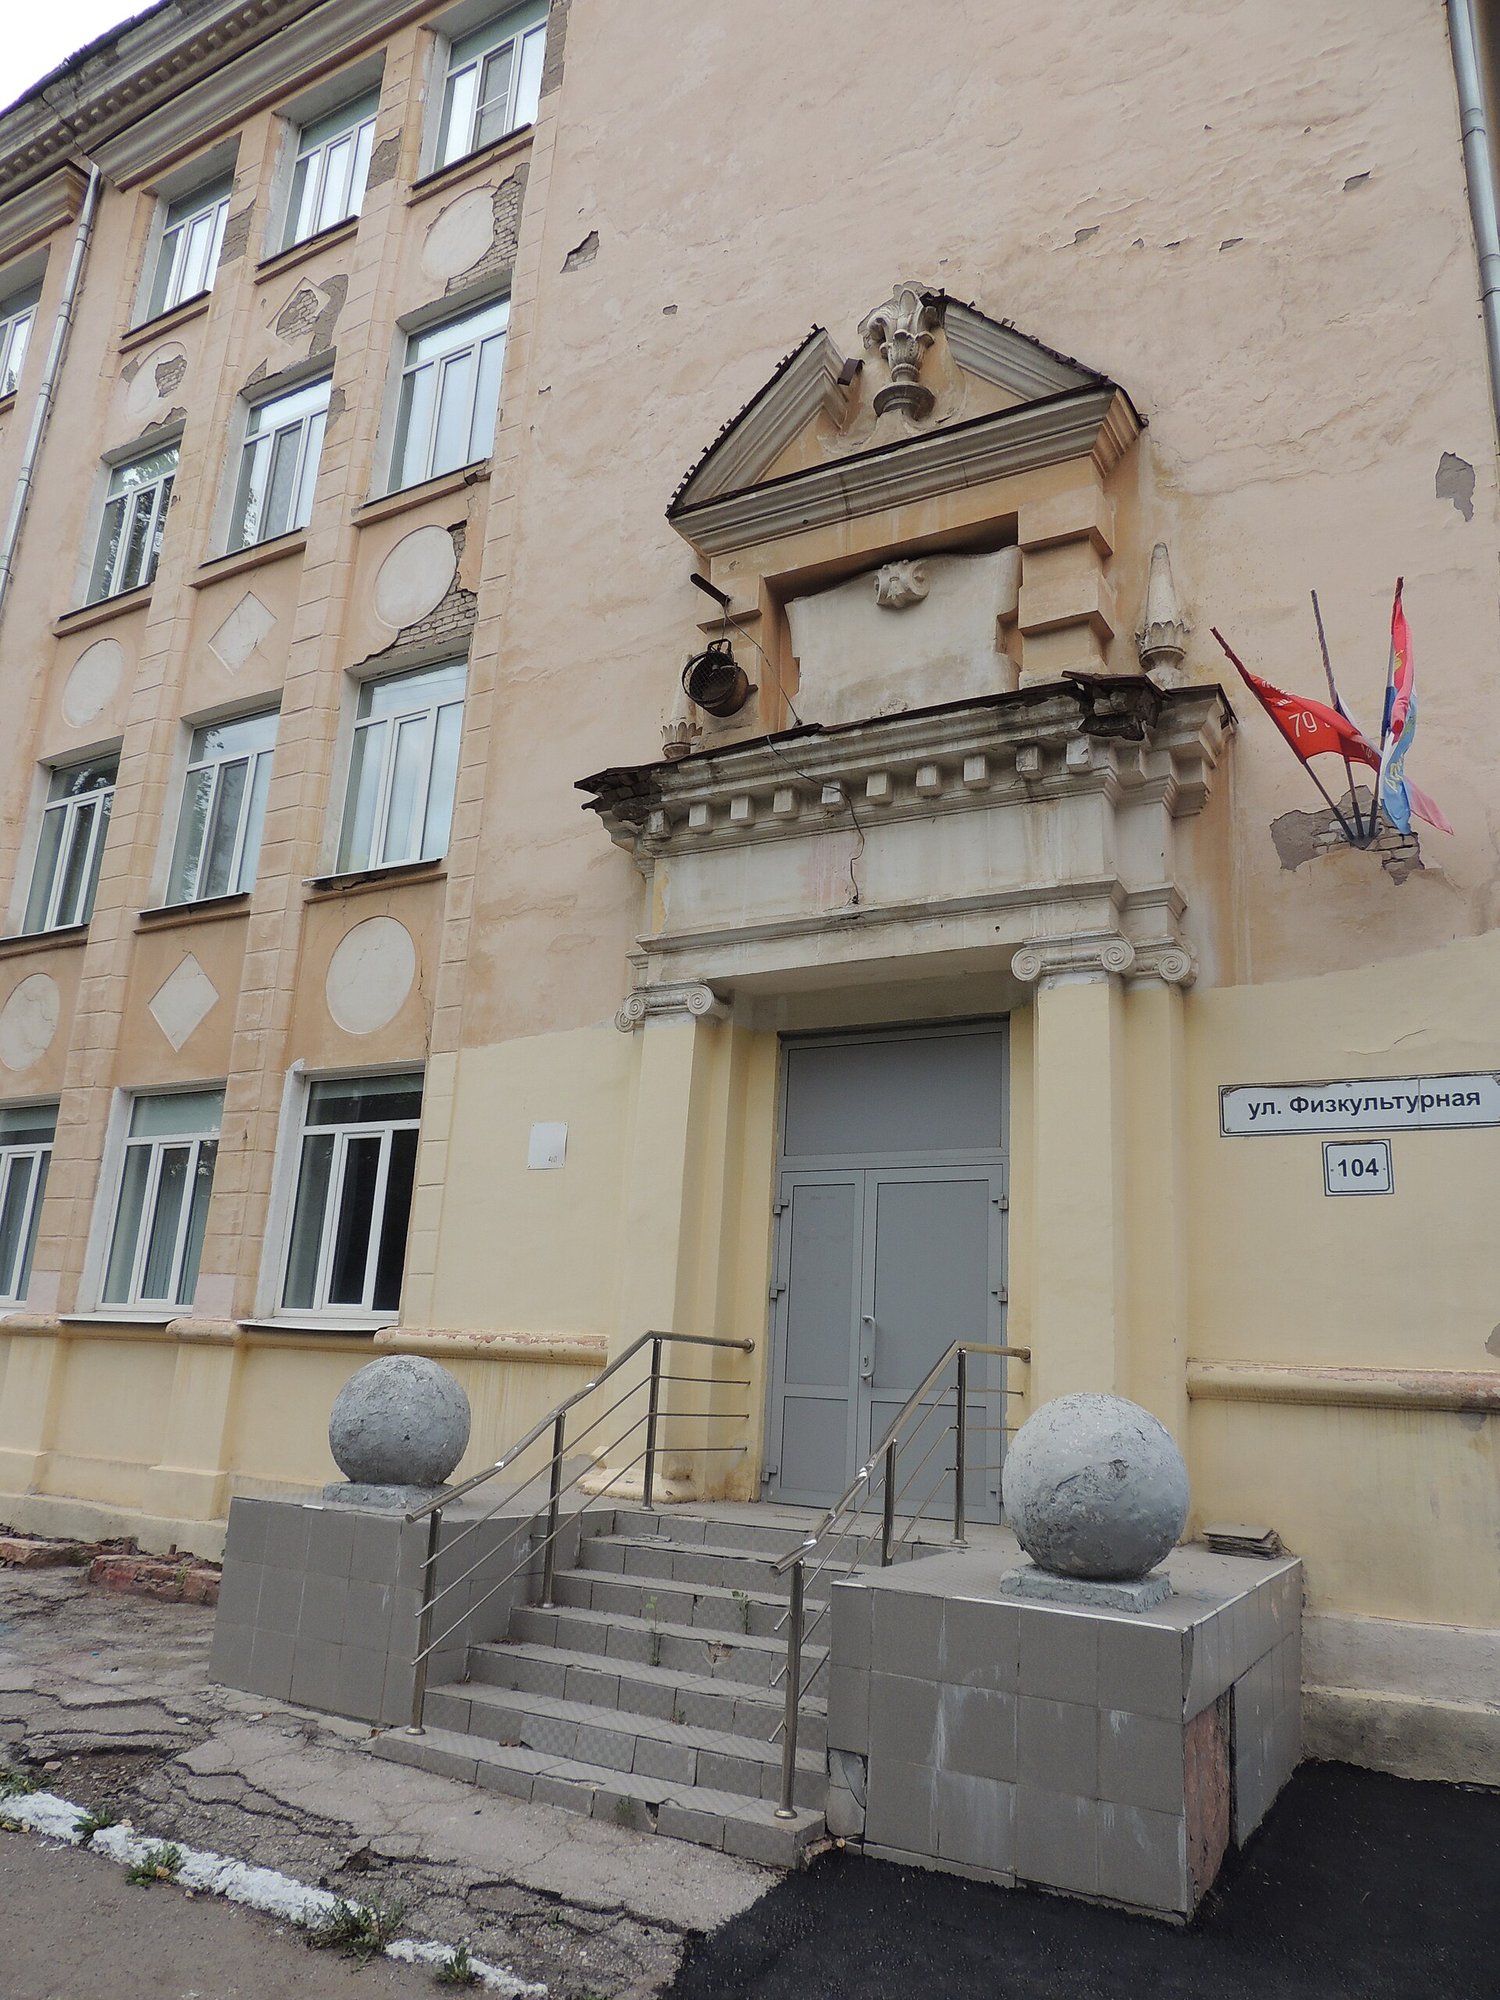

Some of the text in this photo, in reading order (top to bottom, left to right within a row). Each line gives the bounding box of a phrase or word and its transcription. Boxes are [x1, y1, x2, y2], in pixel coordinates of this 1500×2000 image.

[1248, 1091, 1481, 1120] ул. Физкультурная
[1337, 1158, 1379, 1177] 104
